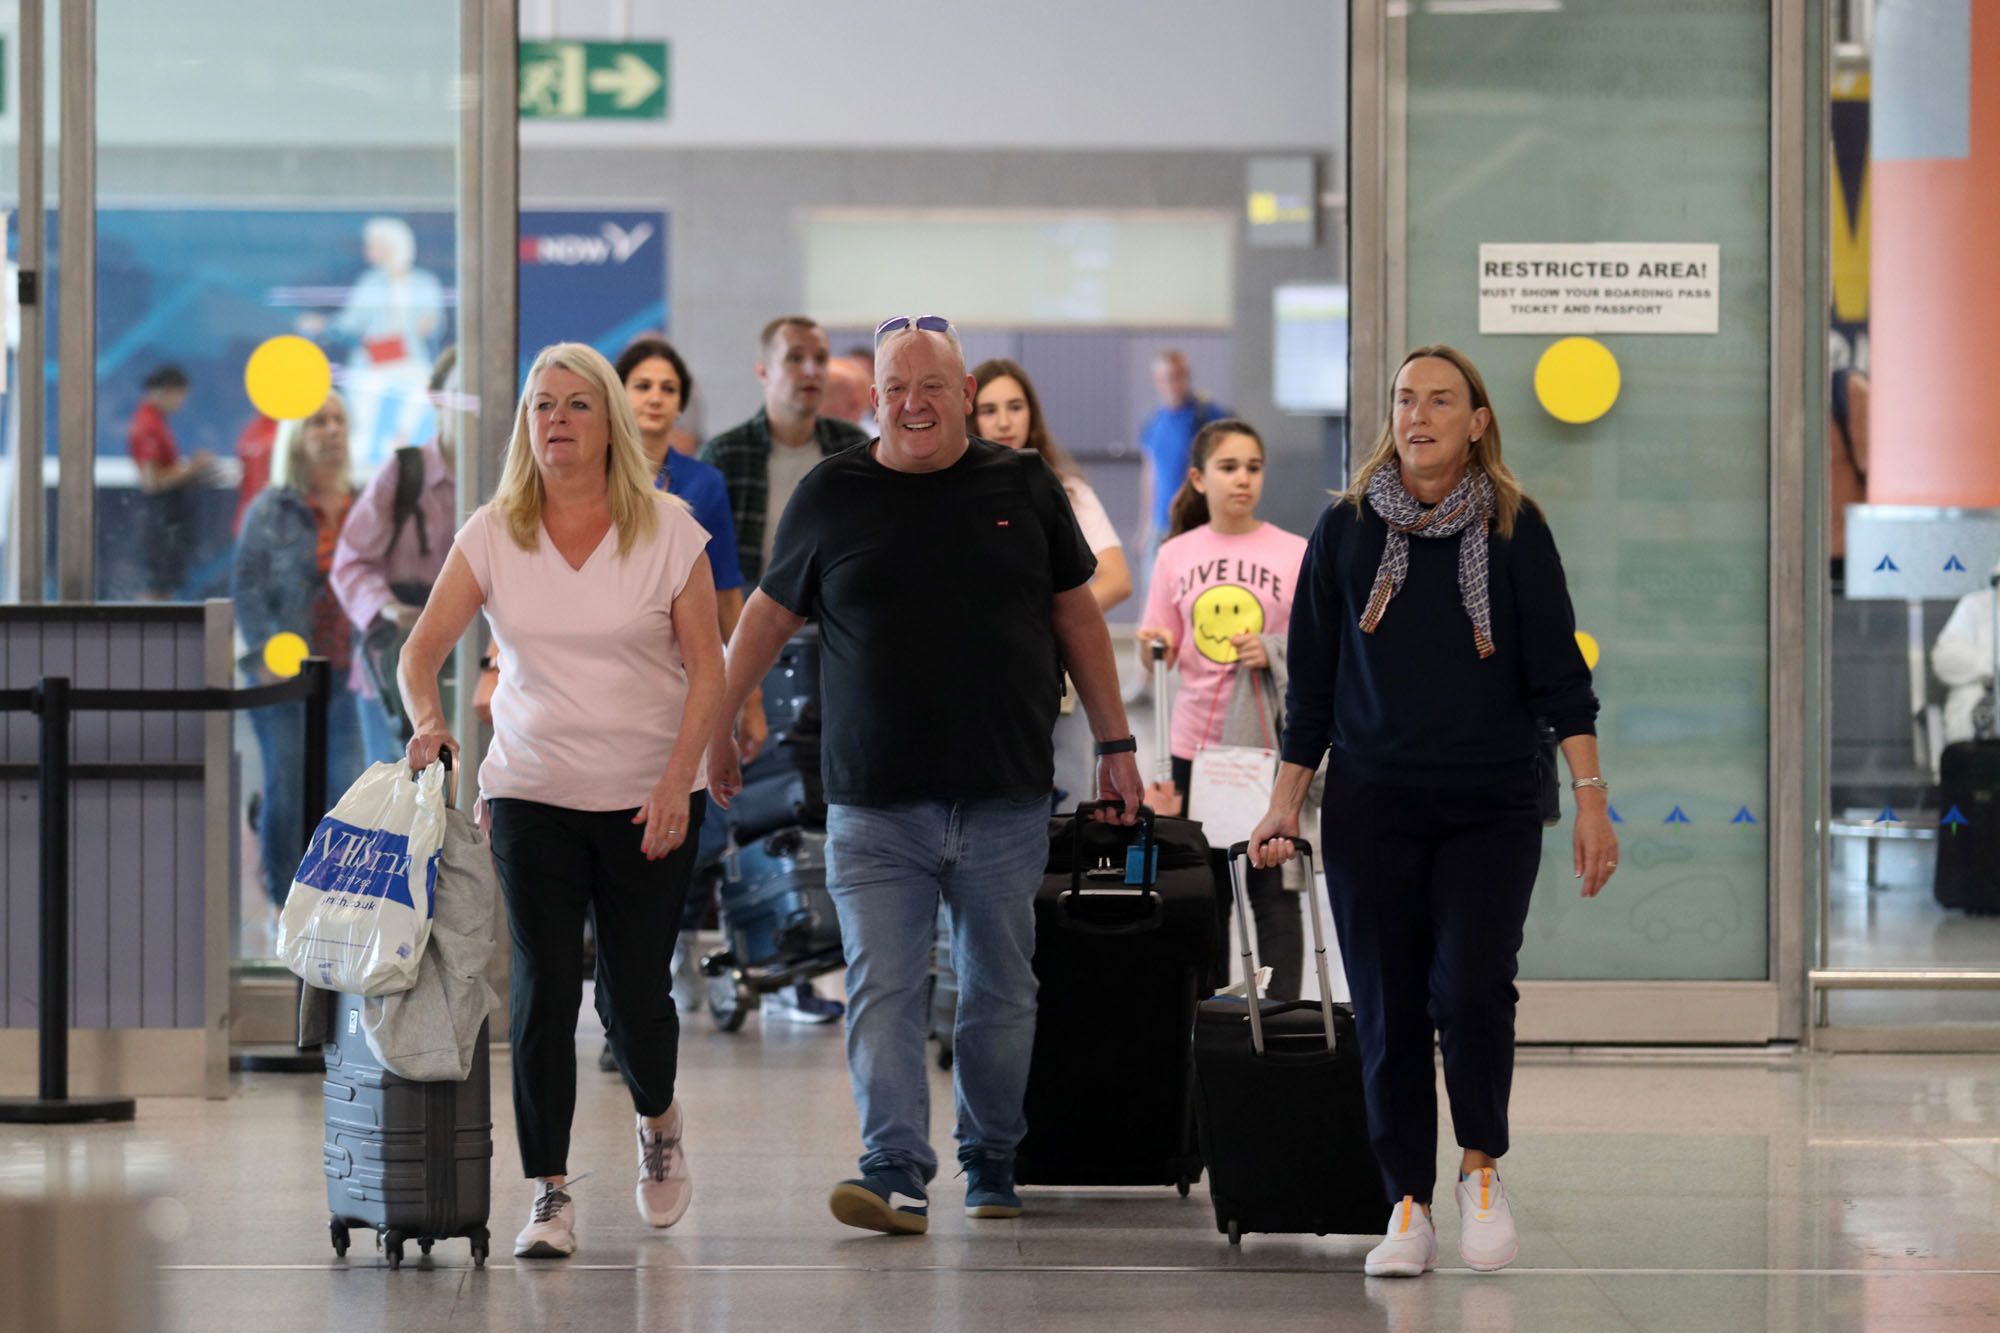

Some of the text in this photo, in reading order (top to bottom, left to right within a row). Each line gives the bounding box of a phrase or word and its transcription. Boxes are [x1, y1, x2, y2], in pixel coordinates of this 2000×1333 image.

[1484, 261, 1629, 278] RESTRICTED
[1637, 261, 1707, 278] AREA!
[1521, 288, 1560, 298] SHOW
[1566, 288, 1599, 298] YOUR
[1604, 288, 1674, 298] BOARDING
[1678, 288, 1712, 298] PASS
[1511, 304, 1662, 315] TICKET AND PASSPORT
[1179, 559, 1281, 602] LIVE LIFE
